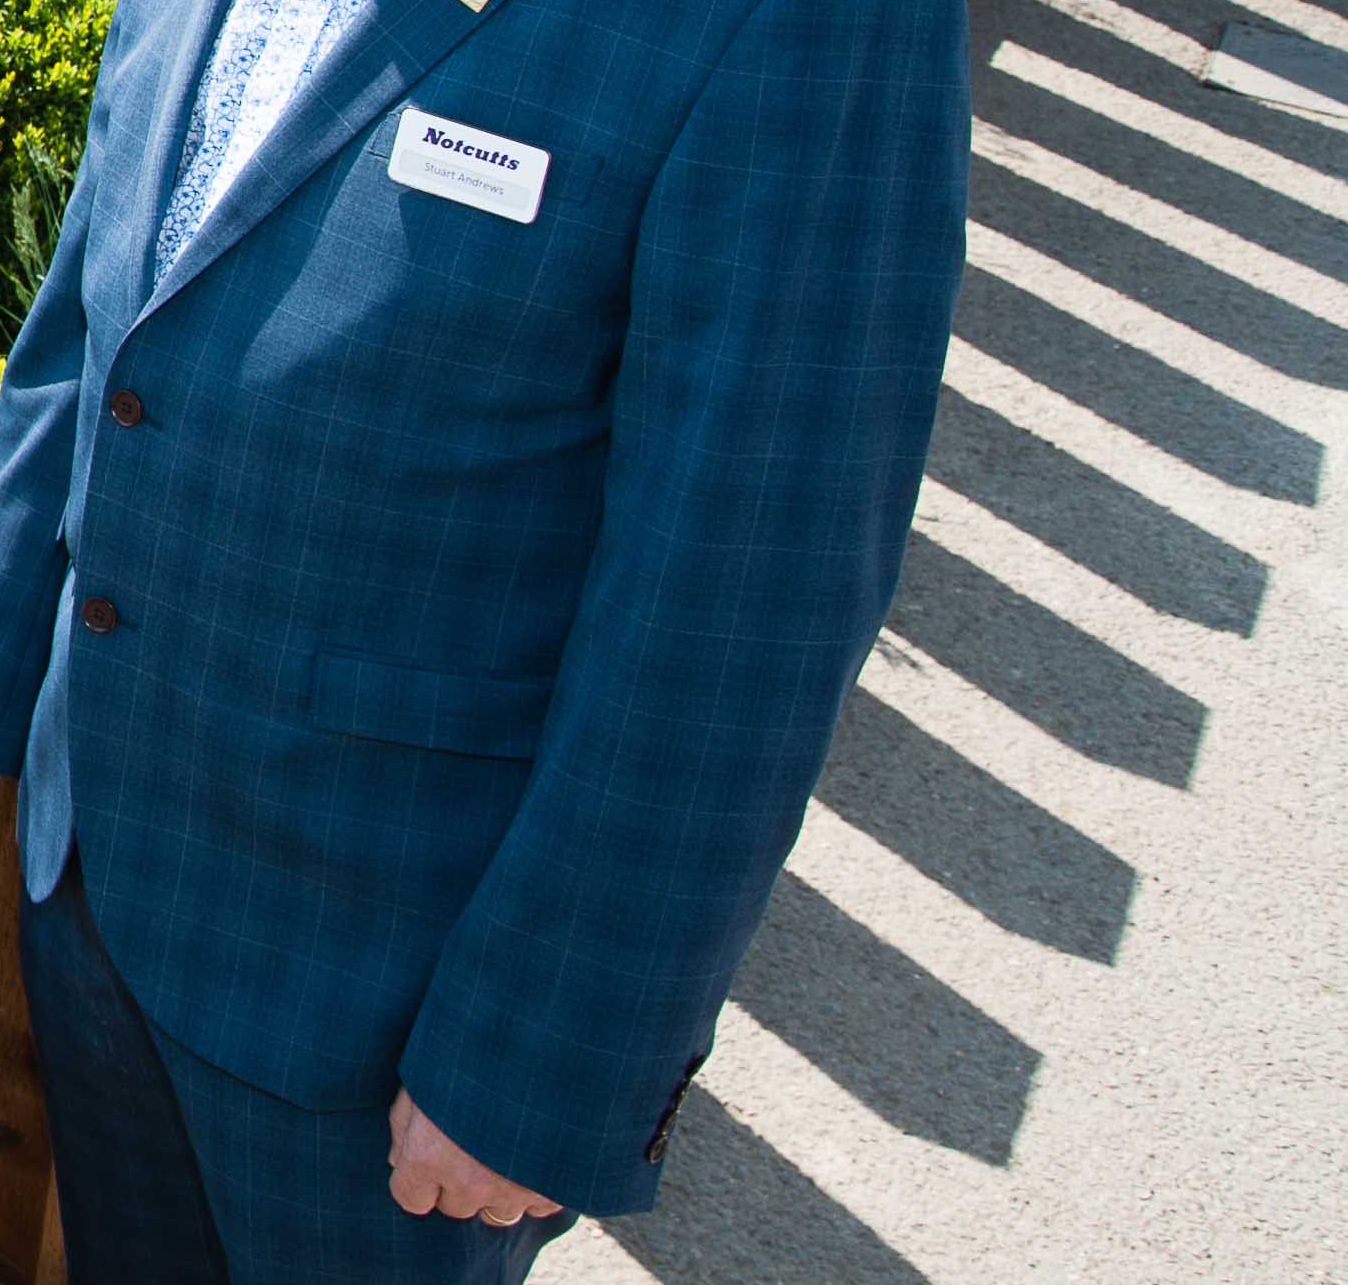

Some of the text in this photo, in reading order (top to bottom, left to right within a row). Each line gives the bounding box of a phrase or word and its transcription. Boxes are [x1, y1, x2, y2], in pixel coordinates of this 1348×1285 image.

[422, 126, 520, 171] Notcutts
[424, 162, 505, 196] Stuart Andrews
